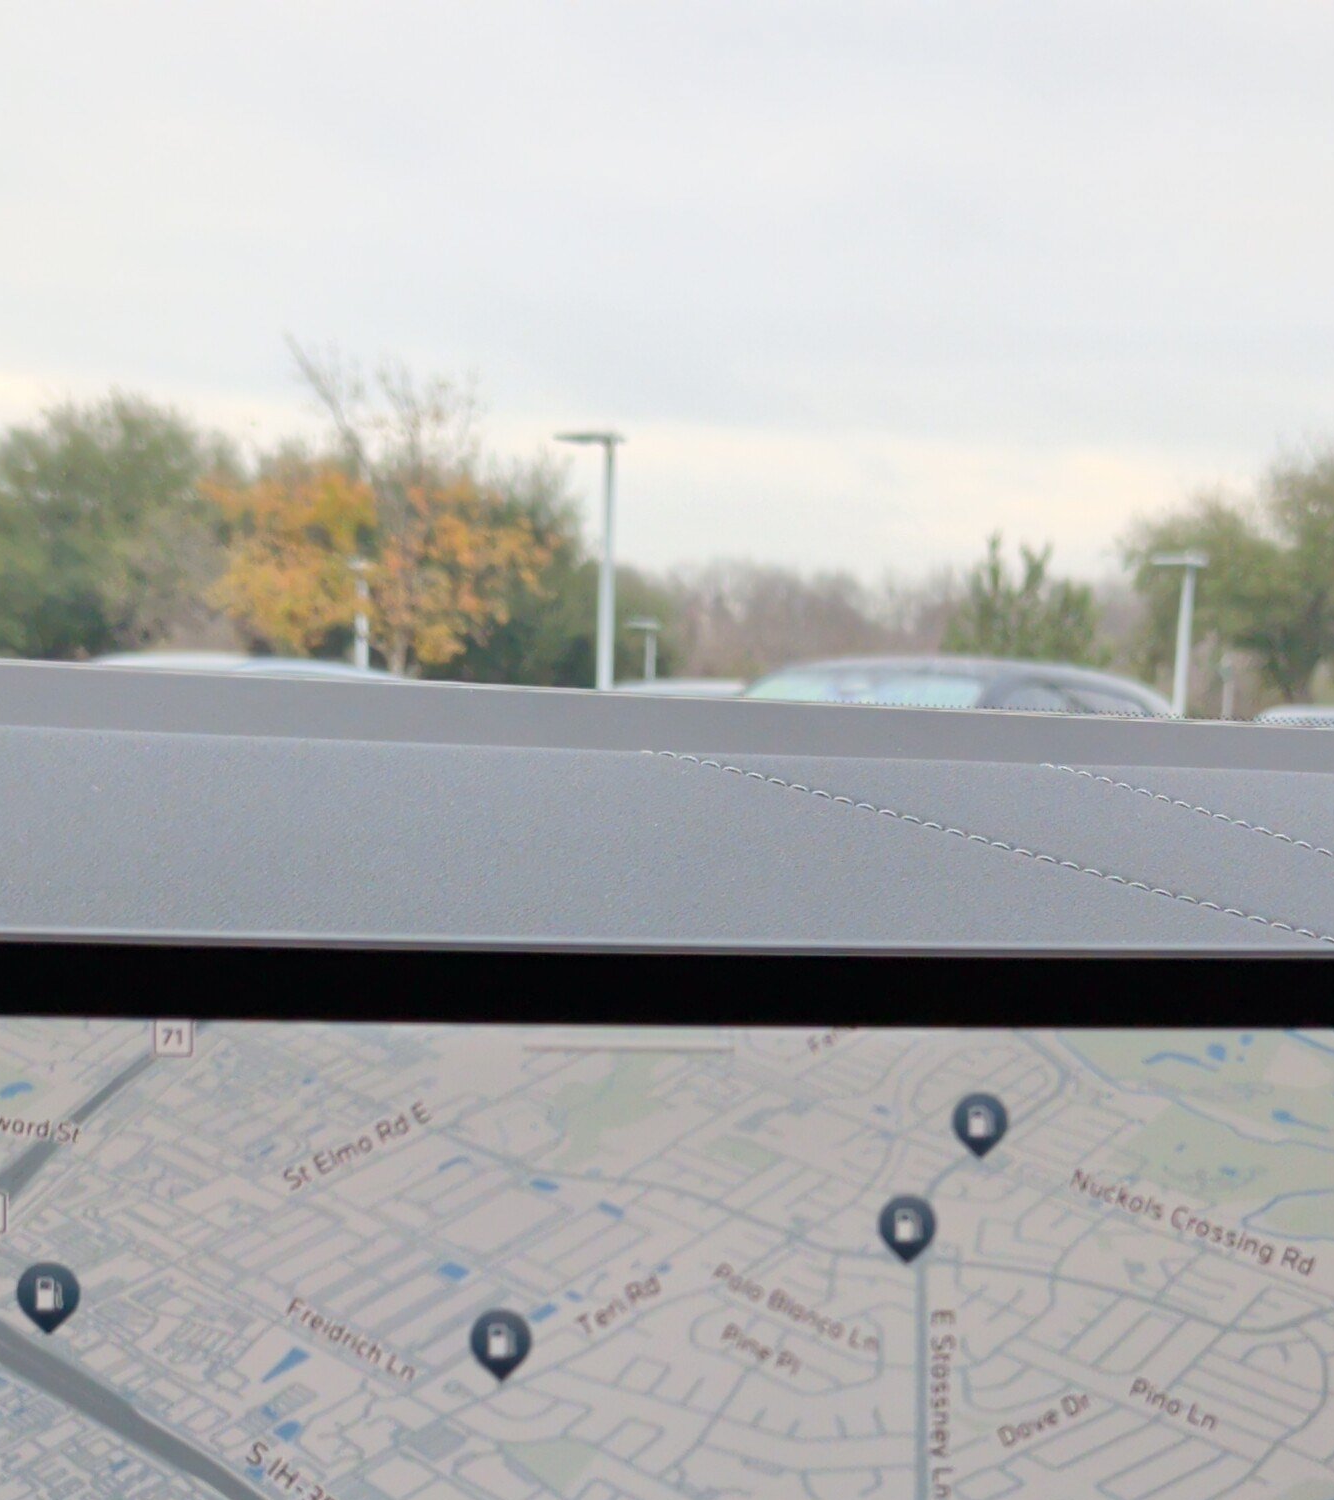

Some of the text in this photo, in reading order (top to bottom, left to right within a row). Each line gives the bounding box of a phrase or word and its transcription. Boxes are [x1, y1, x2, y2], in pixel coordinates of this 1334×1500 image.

[162, 1028, 184, 1046] 71
[56, 1121, 80, 1143] St
[283, 1100, 432, 1191] St Elmo Rd E
[1069, 1168, 1316, 1276] Nuckols Crossing Rd
[930, 1309, 957, 1326] E
[286, 1297, 416, 1382] Freidrich Ln
[1186, 1402, 1218, 1430] Ln
[245, 1441, 269, 1466] S
[931, 1466, 955, 1500] Ln
